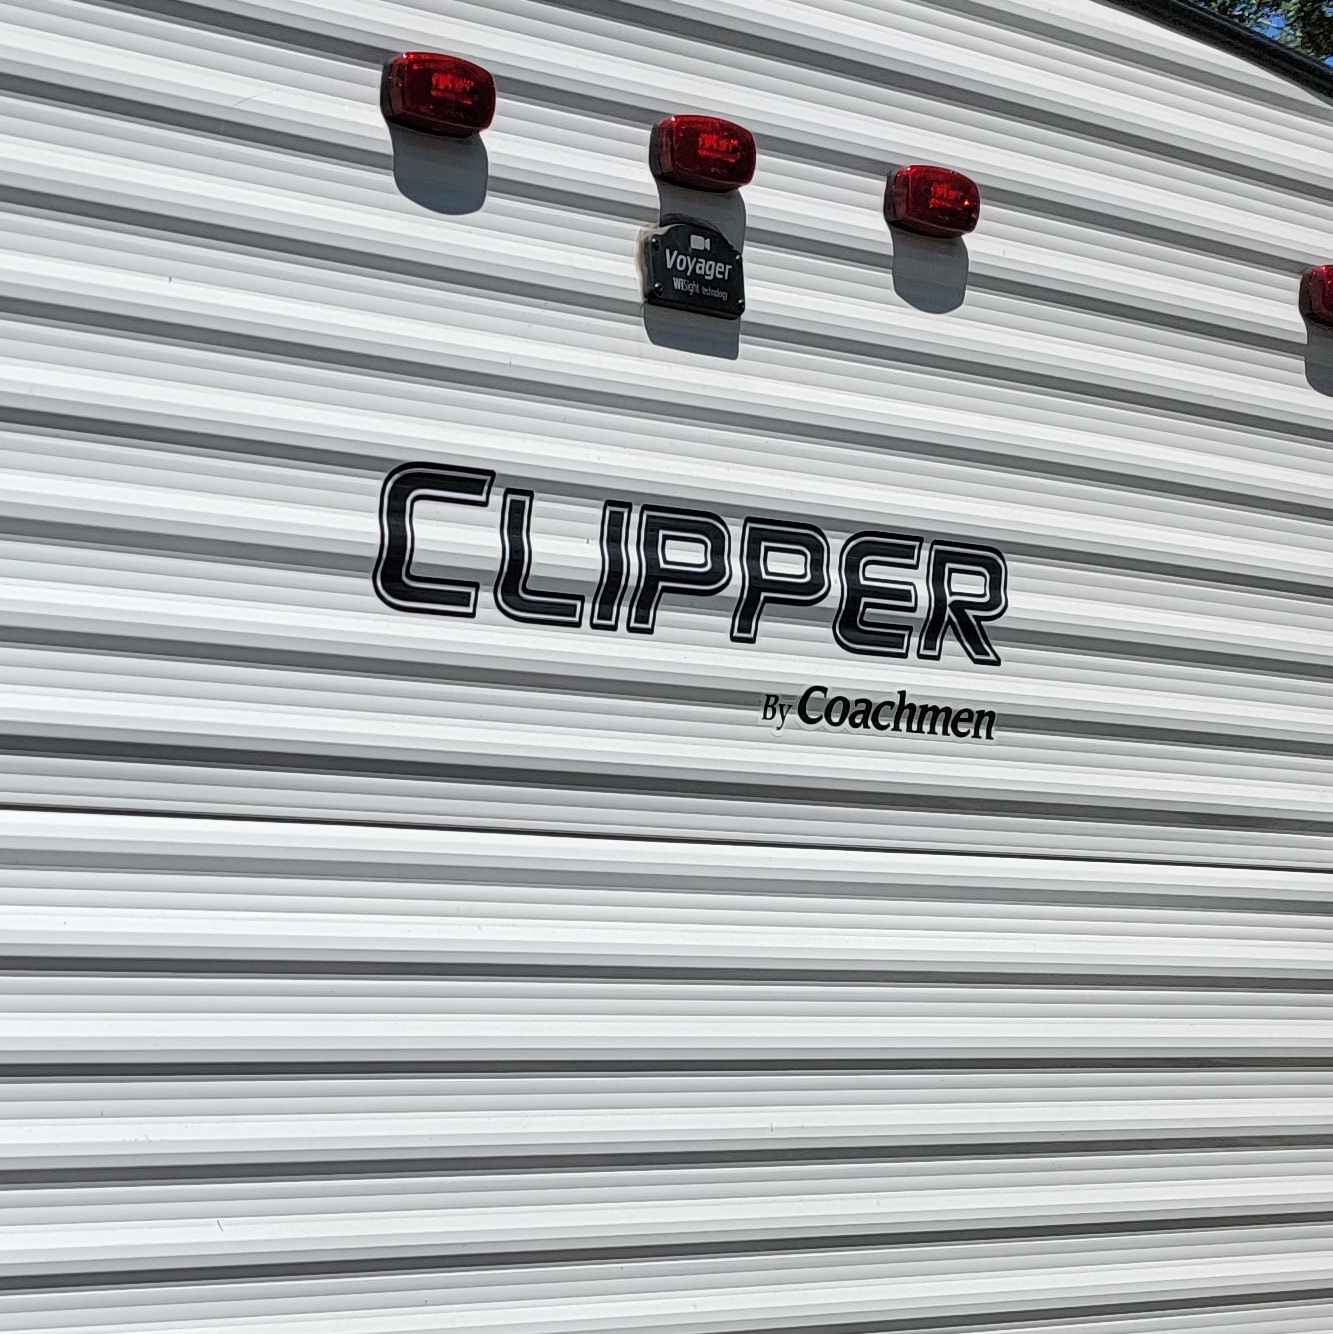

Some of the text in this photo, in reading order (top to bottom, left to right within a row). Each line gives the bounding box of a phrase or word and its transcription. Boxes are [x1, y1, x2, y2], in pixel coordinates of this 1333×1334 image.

[665, 248, 733, 280] Voyager
[372, 461, 1008, 666] CLIPPER
[762, 685, 997, 741] By Coachmen
